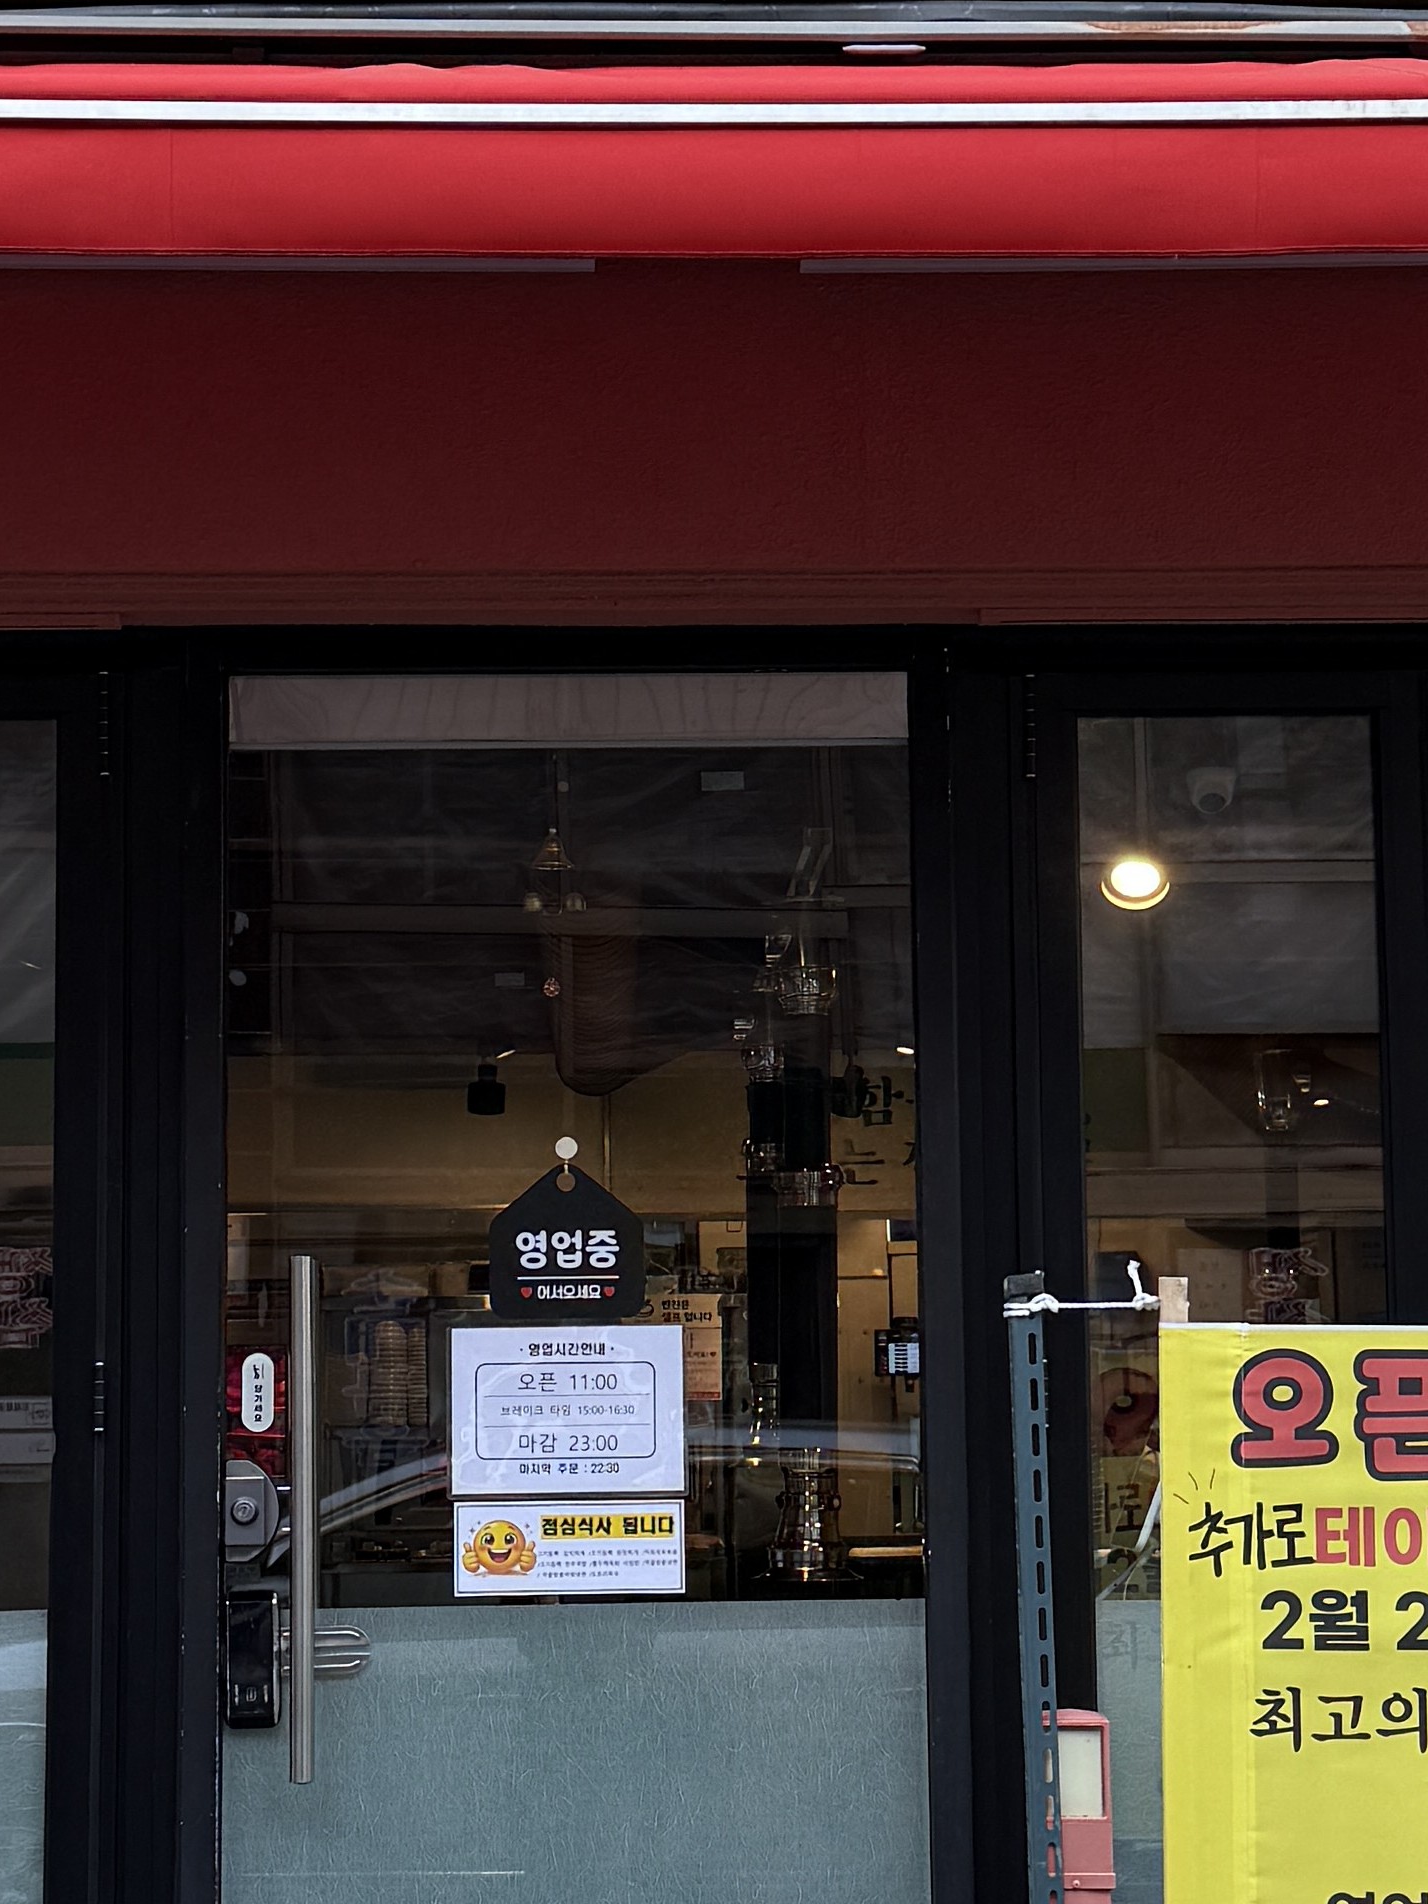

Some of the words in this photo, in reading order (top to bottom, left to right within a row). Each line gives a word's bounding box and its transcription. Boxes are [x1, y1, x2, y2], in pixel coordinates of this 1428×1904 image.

[516, 1230, 619, 1268] 영업중
[537, 1284, 602, 1301] 어서오세요
[528, 1342, 606, 1357] 영업시간안내
[518, 1373, 557, 1392] 오픈
[570, 1374, 617, 1390] 11:00
[501, 1406, 543, 1416] 브레이크
[550, 1405, 570, 1416] 타임
[579, 1406, 634, 1415] 15:00-16:30
[519, 1433, 557, 1453] 마감
[570, 1435, 618, 1451] 23:00
[520, 1463, 551, 1474] 마지막
[558, 1463, 578, 1474] 주문
[591, 1463, 619, 1473] 22:30
[541, 1516, 613, 1536] 점심식사
[622, 1515, 675, 1535] 됩니다
[1189, 1502, 1316, 1577] 추가로
[1261, 1590, 1370, 1651] 2월
[1250, 1687, 1427, 1753] 최고의
